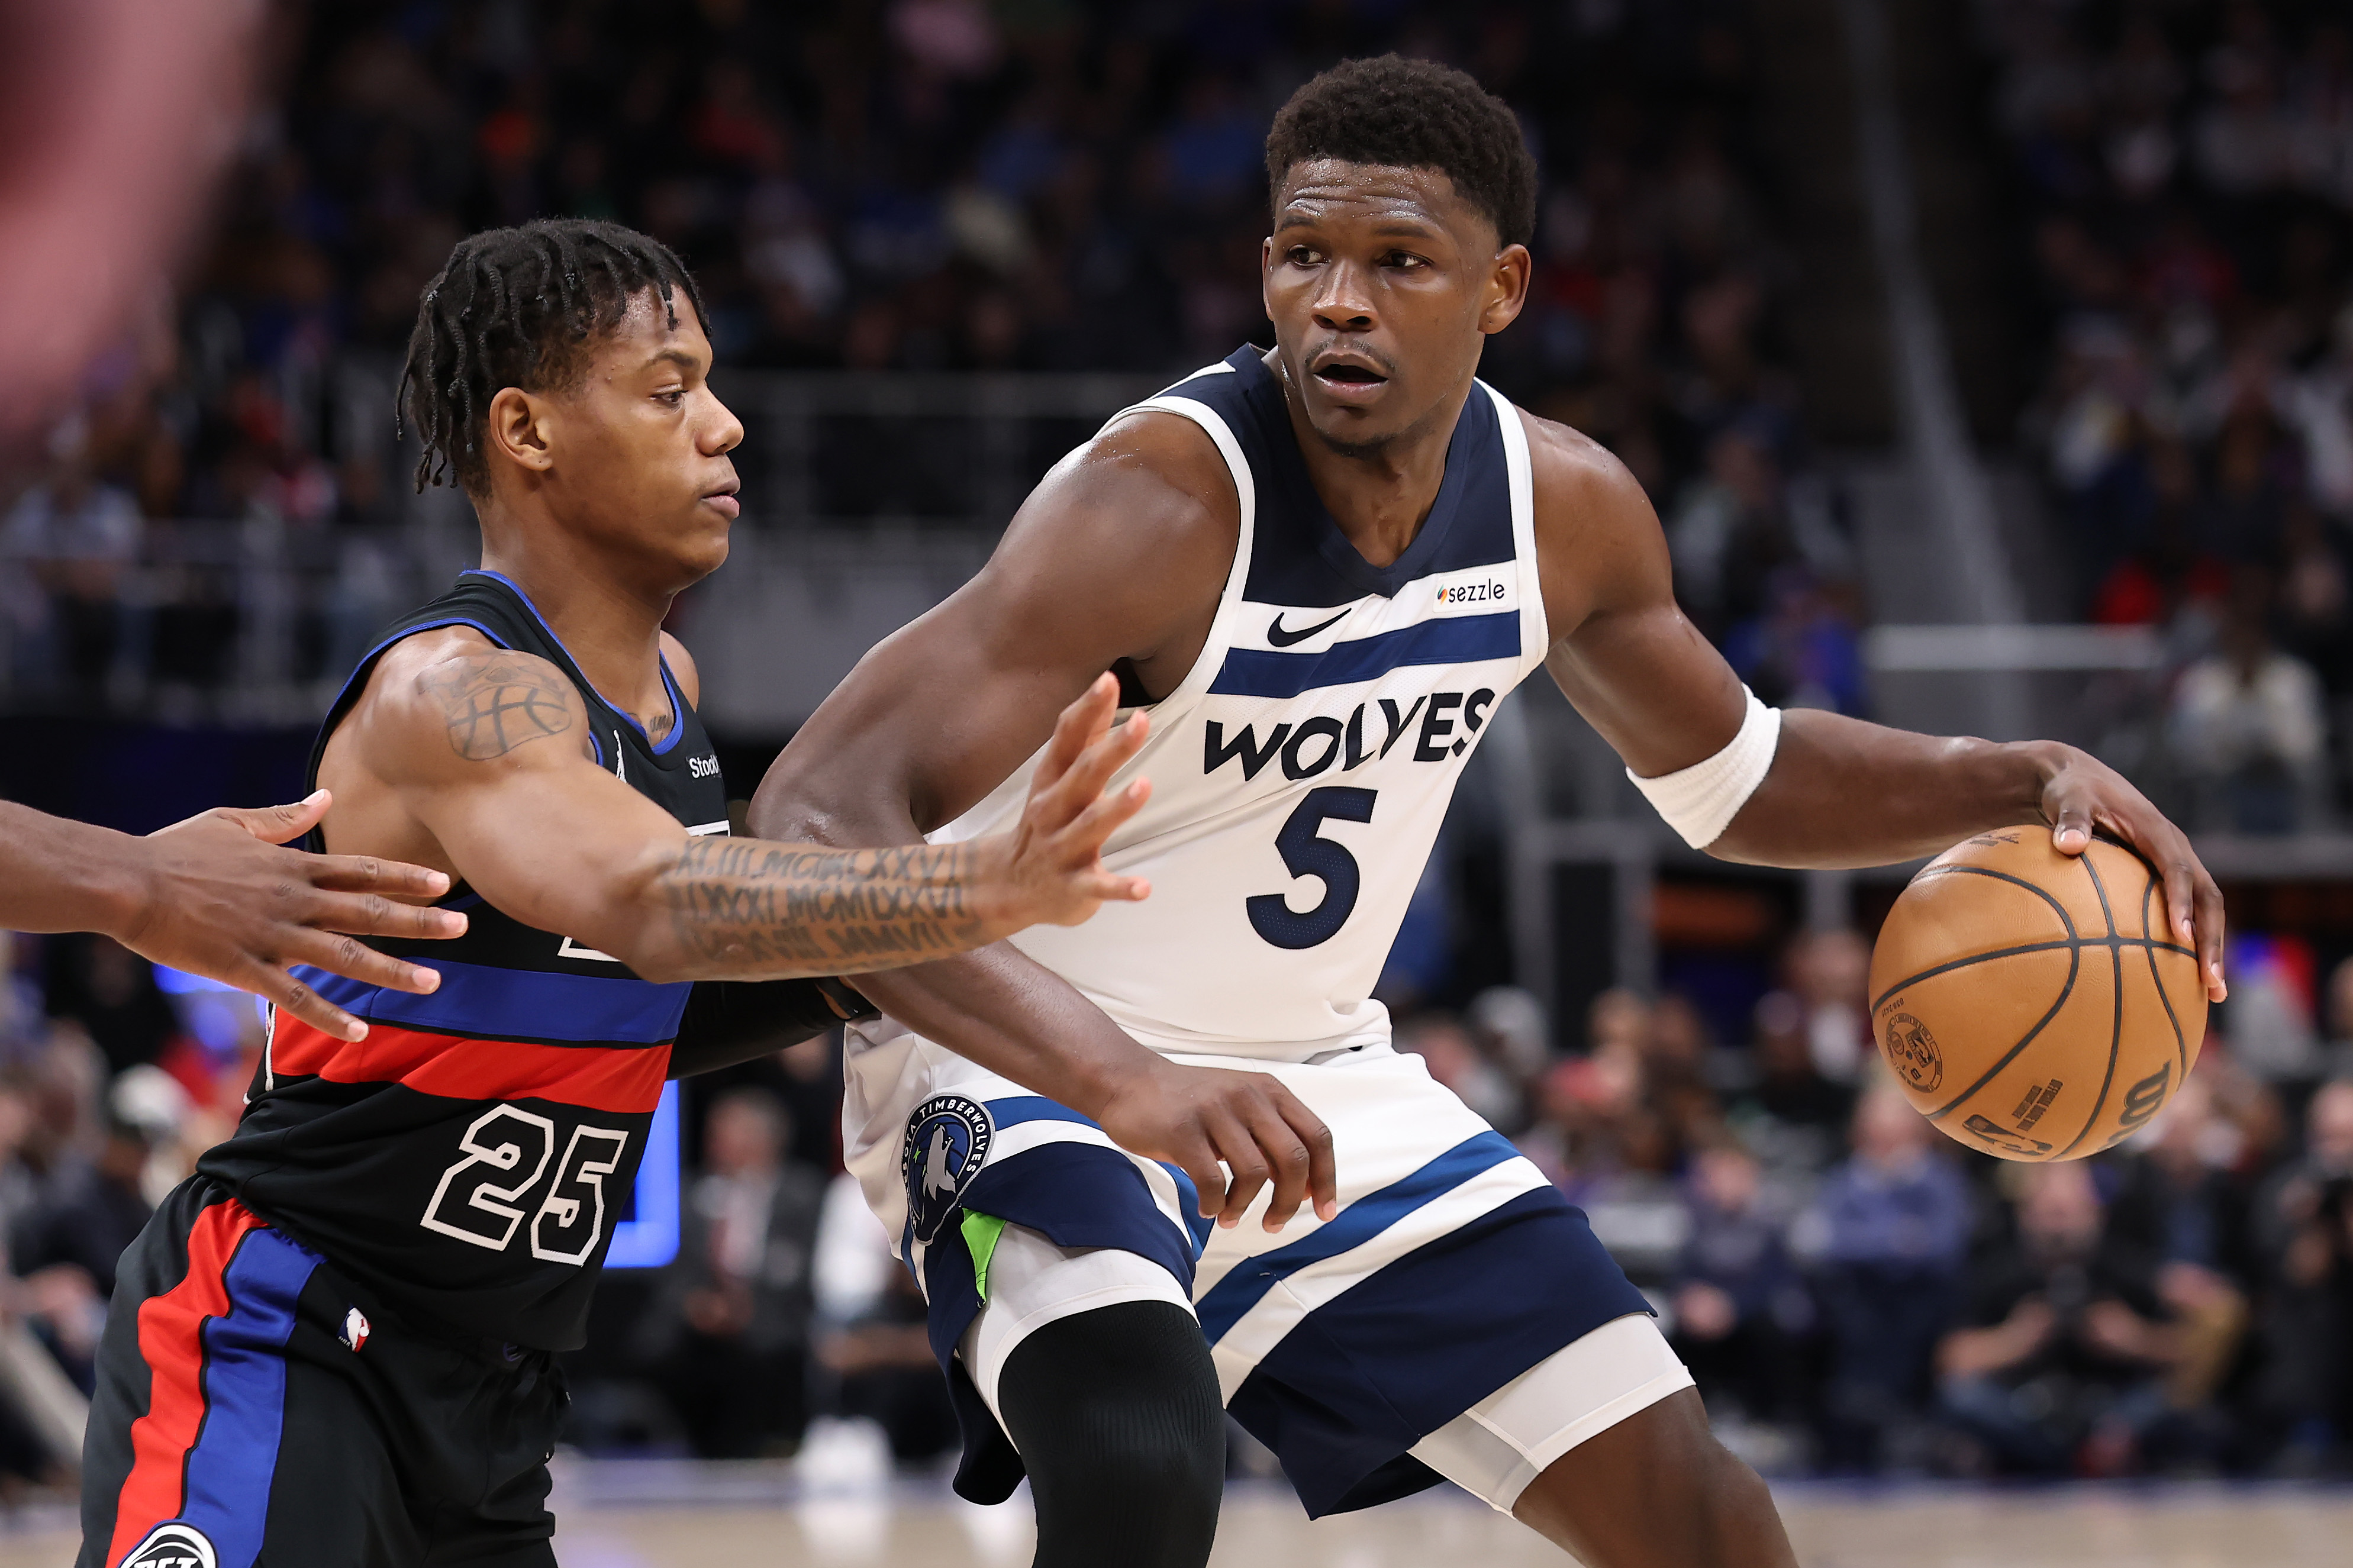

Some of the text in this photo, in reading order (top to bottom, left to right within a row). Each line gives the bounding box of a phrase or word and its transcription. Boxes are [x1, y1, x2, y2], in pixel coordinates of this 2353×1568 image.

[1449, 579, 1504, 602] sezzle
[1204, 688, 1495, 782] WOLVES
[1246, 786, 1378, 950] 5
[919, 1099, 988, 1173] TIMBERWOLVES
[420, 1103, 628, 1267] 25
